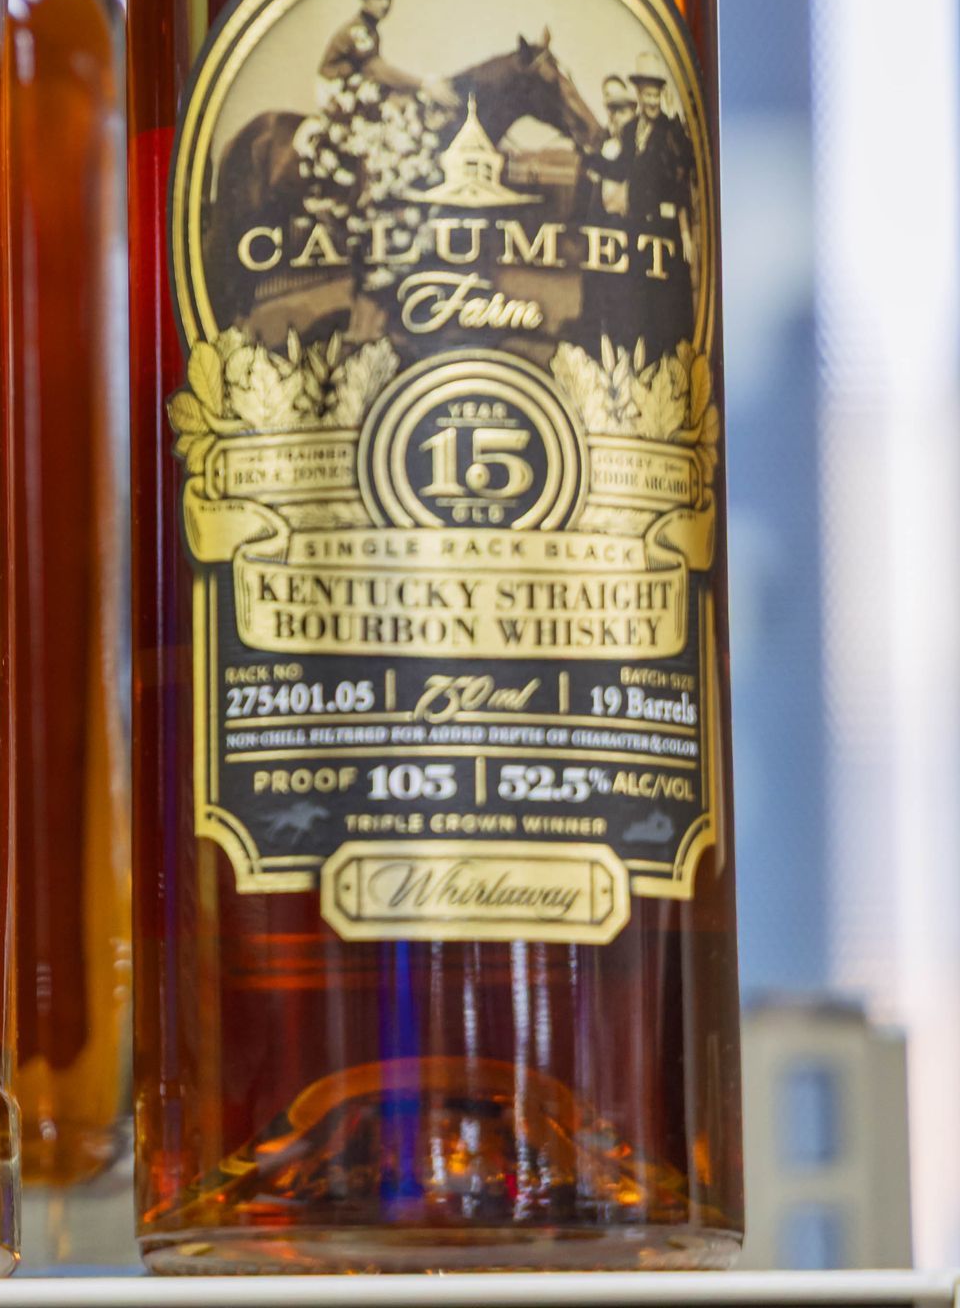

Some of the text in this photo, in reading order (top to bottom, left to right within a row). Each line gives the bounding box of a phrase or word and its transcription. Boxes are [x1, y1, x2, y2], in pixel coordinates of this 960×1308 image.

[238, 218, 676, 280] CALUMET
[397, 271, 544, 334] Farm
[448, 400, 507, 419] YEAR
[418, 427, 534, 499] 15
[451, 503, 505, 523] OLD
[304, 538, 636, 565] SINGLE RACK BLACK
[256, 573, 673, 612] KENTUCKY STRAIGHT
[273, 609, 666, 647] BOURBON WHISKEY
[620, 666, 696, 691] BATCH SIZE
[224, 679, 375, 718] 275401.05
[590, 685, 623, 717] 19
[626, 686, 698, 726] Barrels
[253, 763, 696, 803] PROOF 105 52.5% ALC/VOL
[345, 812, 608, 837] TRIPLE CROWN WINNER
[367, 860, 584, 917] Whirlaway
